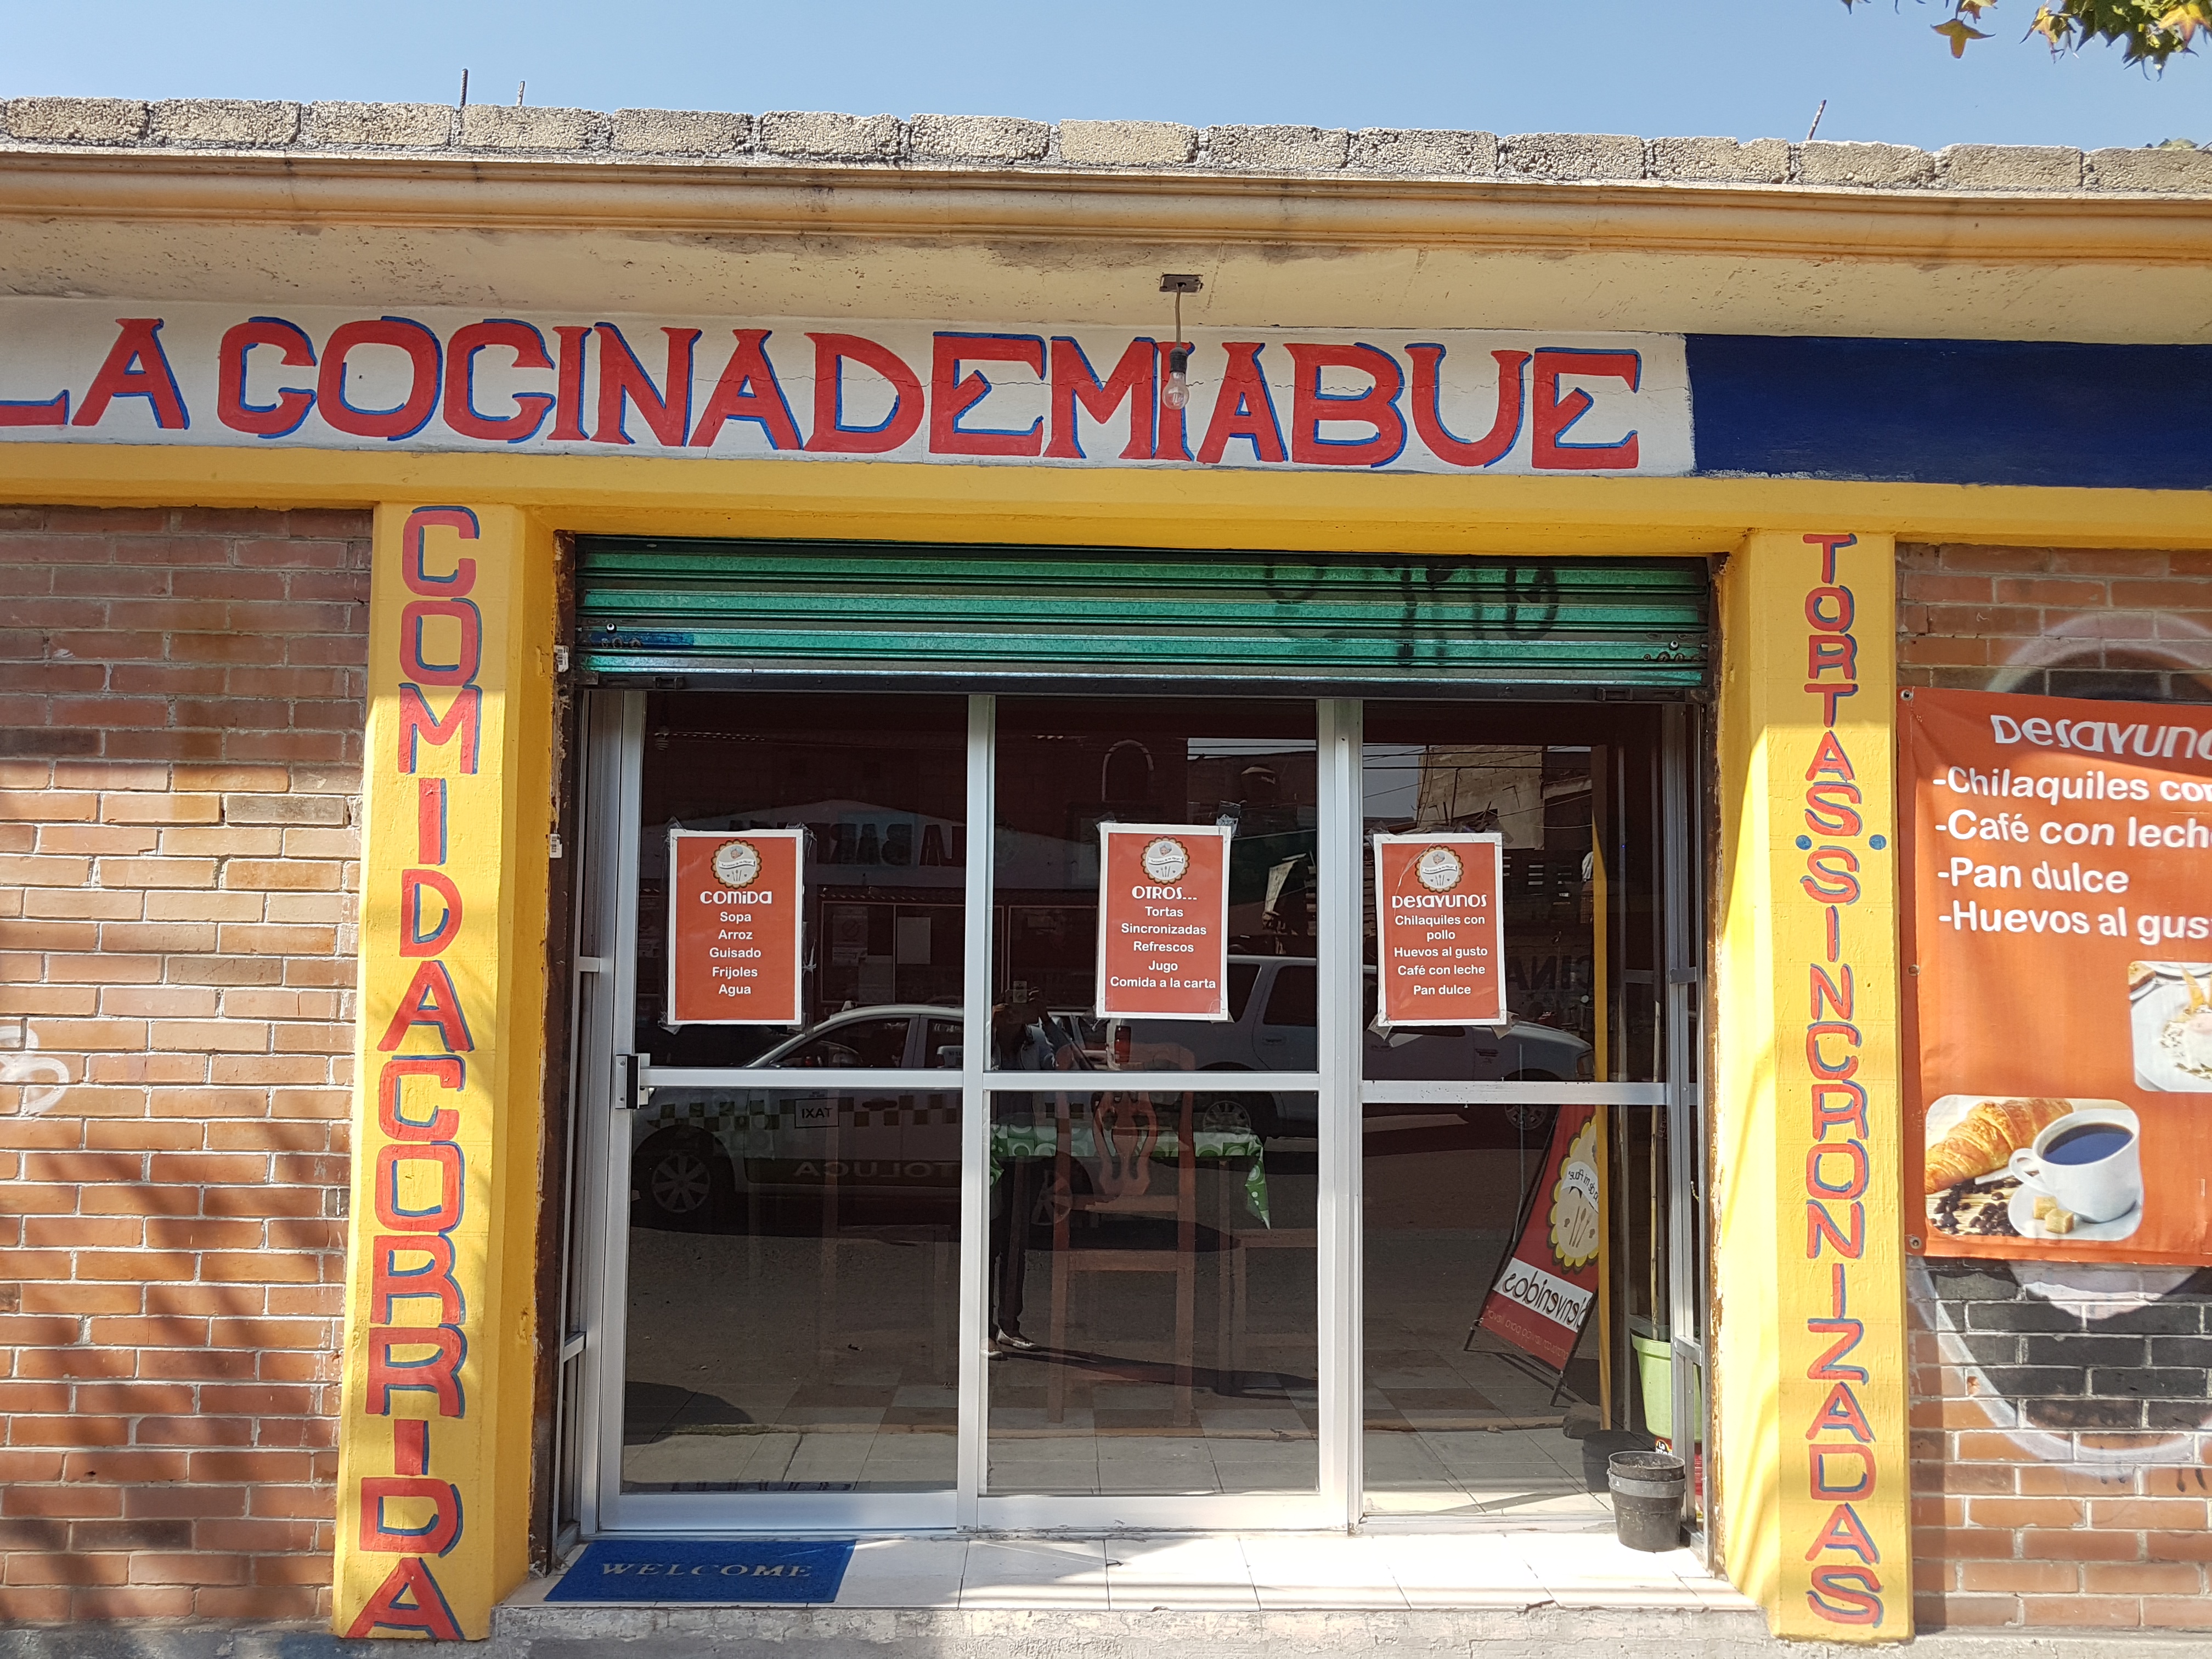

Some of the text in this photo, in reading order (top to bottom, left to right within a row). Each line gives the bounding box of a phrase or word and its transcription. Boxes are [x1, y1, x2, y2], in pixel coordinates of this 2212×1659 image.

[2040, 821, 2115, 847] con
[2128, 816, 2212, 848] lech
[2032, 861, 2129, 893] dulce
[720, 911, 752, 924] Sopa
[1144, 906, 1184, 917] Tortas
[1395, 915, 1486, 927] Chilaquiles con
[2098, 907, 2128, 936] al
[2137, 915, 2212, 946] gus
[718, 929, 753, 940] Arroz
[1121, 923, 1207, 935] Sincronizadas
[1426, 929, 1455, 943] pollo
[709, 947, 761, 958] Guisado
[1133, 940, 1194, 953] Refrescos
[1394, 946, 1488, 959] Huevos al gusto
[712, 966, 758, 979] Frijoles
[1148, 960, 1178, 973] Jugo
[1397, 964, 1486, 976] Café con leche
[1109, 976, 1216, 989] Comida a la carta
[718, 984, 752, 997] Agua
[1413, 984, 1471, 996] Pan dulce
[602, 1562, 813, 1578] WELCOME
